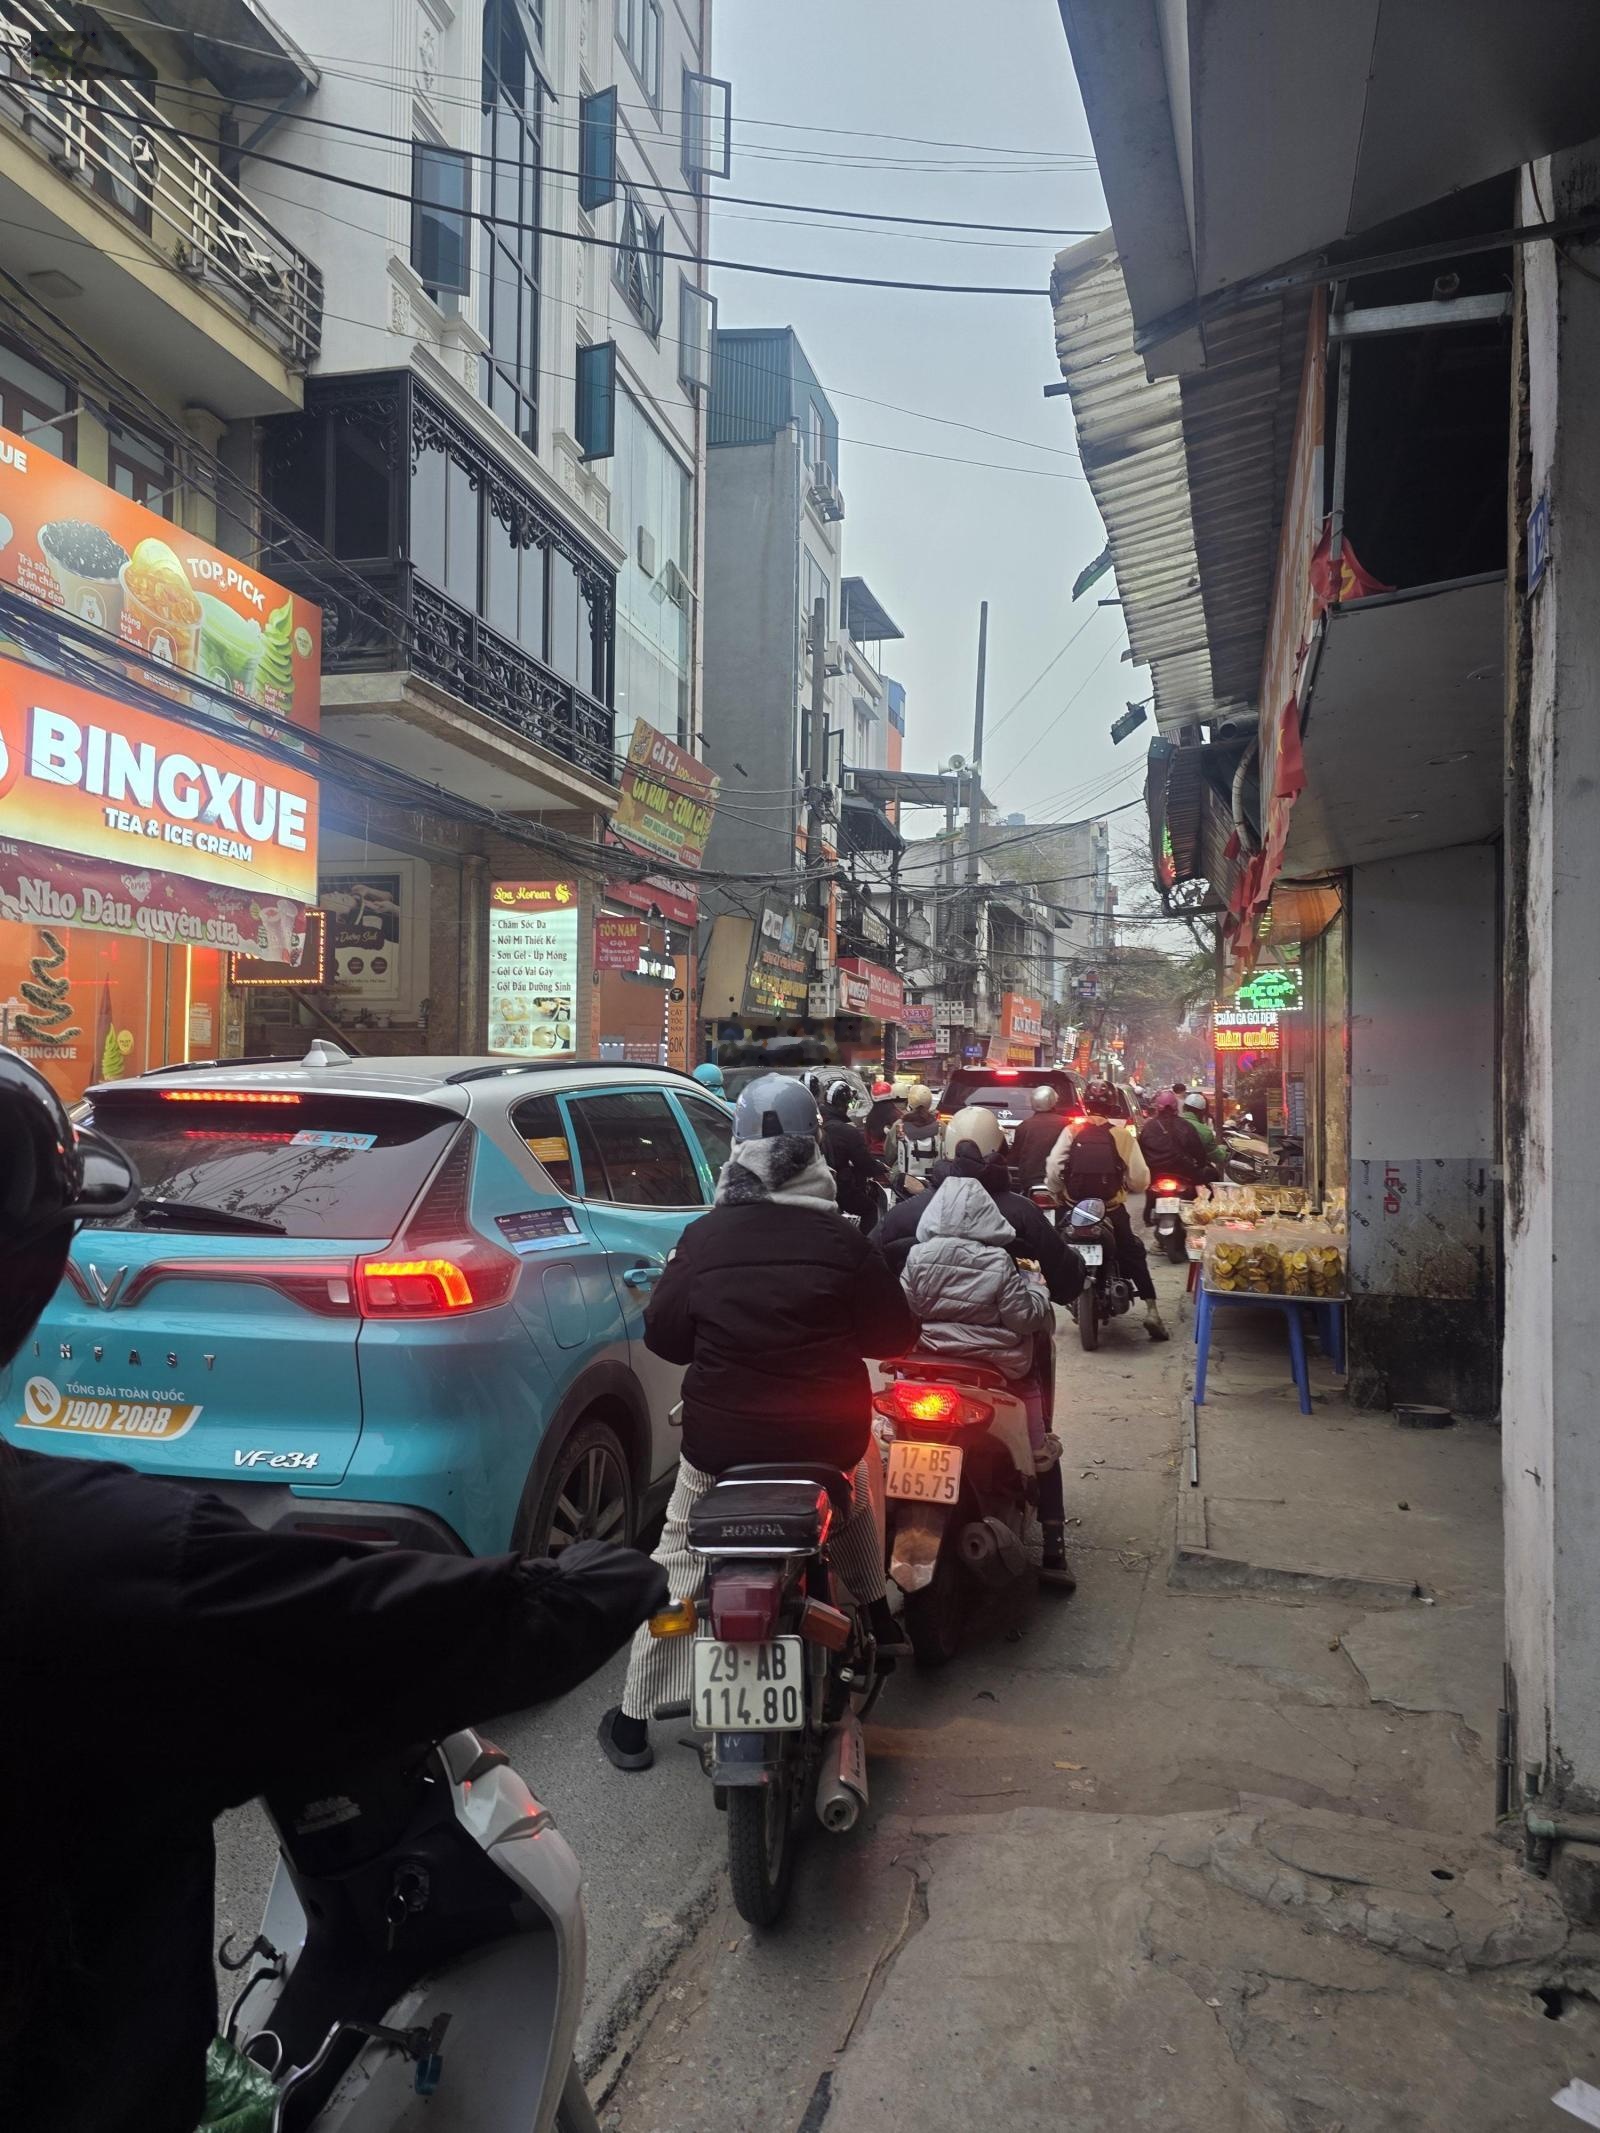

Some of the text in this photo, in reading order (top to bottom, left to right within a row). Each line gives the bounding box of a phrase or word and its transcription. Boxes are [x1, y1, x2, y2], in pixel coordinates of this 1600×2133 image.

[18, 552, 32, 568] Trà
[39, 575, 60, 591] châu
[186, 558, 266, 612] TOP PICK
[30, 706, 307, 851] BINGXUE
[105, 807, 253, 862] TEA & ICE CREAM
[18, 876, 77, 920] Nho
[81, 887, 133, 928] Dâu
[493, 887, 552, 905] Spa Korean
[521, 920, 534, 929] Sóc
[536, 920, 547, 929] Da
[617, 923, 638, 937] NAM
[525, 966, 537, 976] Vai
[555, 981, 572, 992] Sinh
[20, 1046, 77, 1060] BINGXUE
[330, 1135, 369, 1147] TAXI
[32, 1340, 217, 1371] INFAST
[66, 1381, 186, 1402] TỔNG ĐÀI TOÀN QUỐC
[61, 1400, 173, 1434] 1900 2088
[901, 1446, 952, 1473] 17-B5
[889, 1470, 956, 1500] 465.75
[721, 1523, 785, 1537] HONDA
[709, 1643, 787, 1683] 29-AB
[701, 1686, 798, 1726] 114.80
